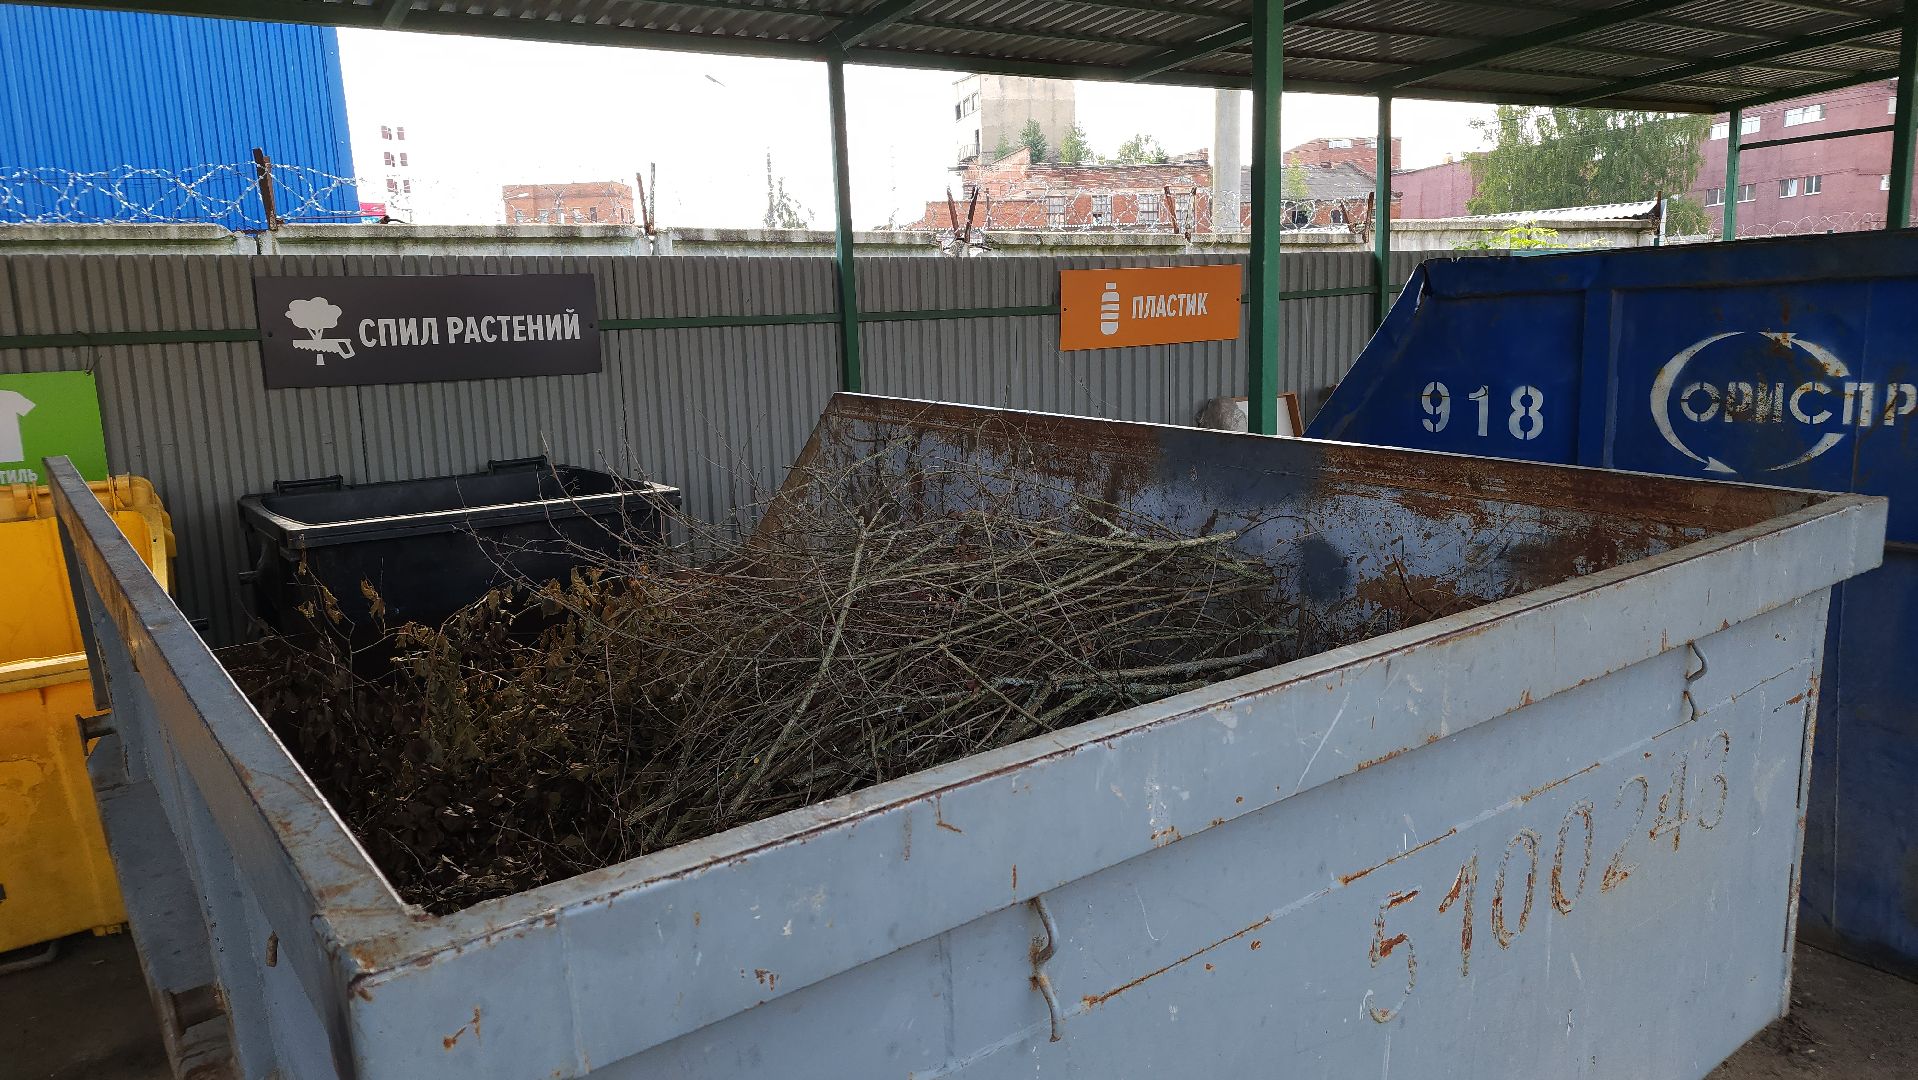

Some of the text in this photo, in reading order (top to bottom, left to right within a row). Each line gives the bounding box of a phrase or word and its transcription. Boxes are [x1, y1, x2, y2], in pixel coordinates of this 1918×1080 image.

[1131, 292, 1209, 319] ПЛАСТИК
[358, 308, 581, 347] СПИЛ РАСТЕНИЙ
[1421, 381, 1544, 441] 918
